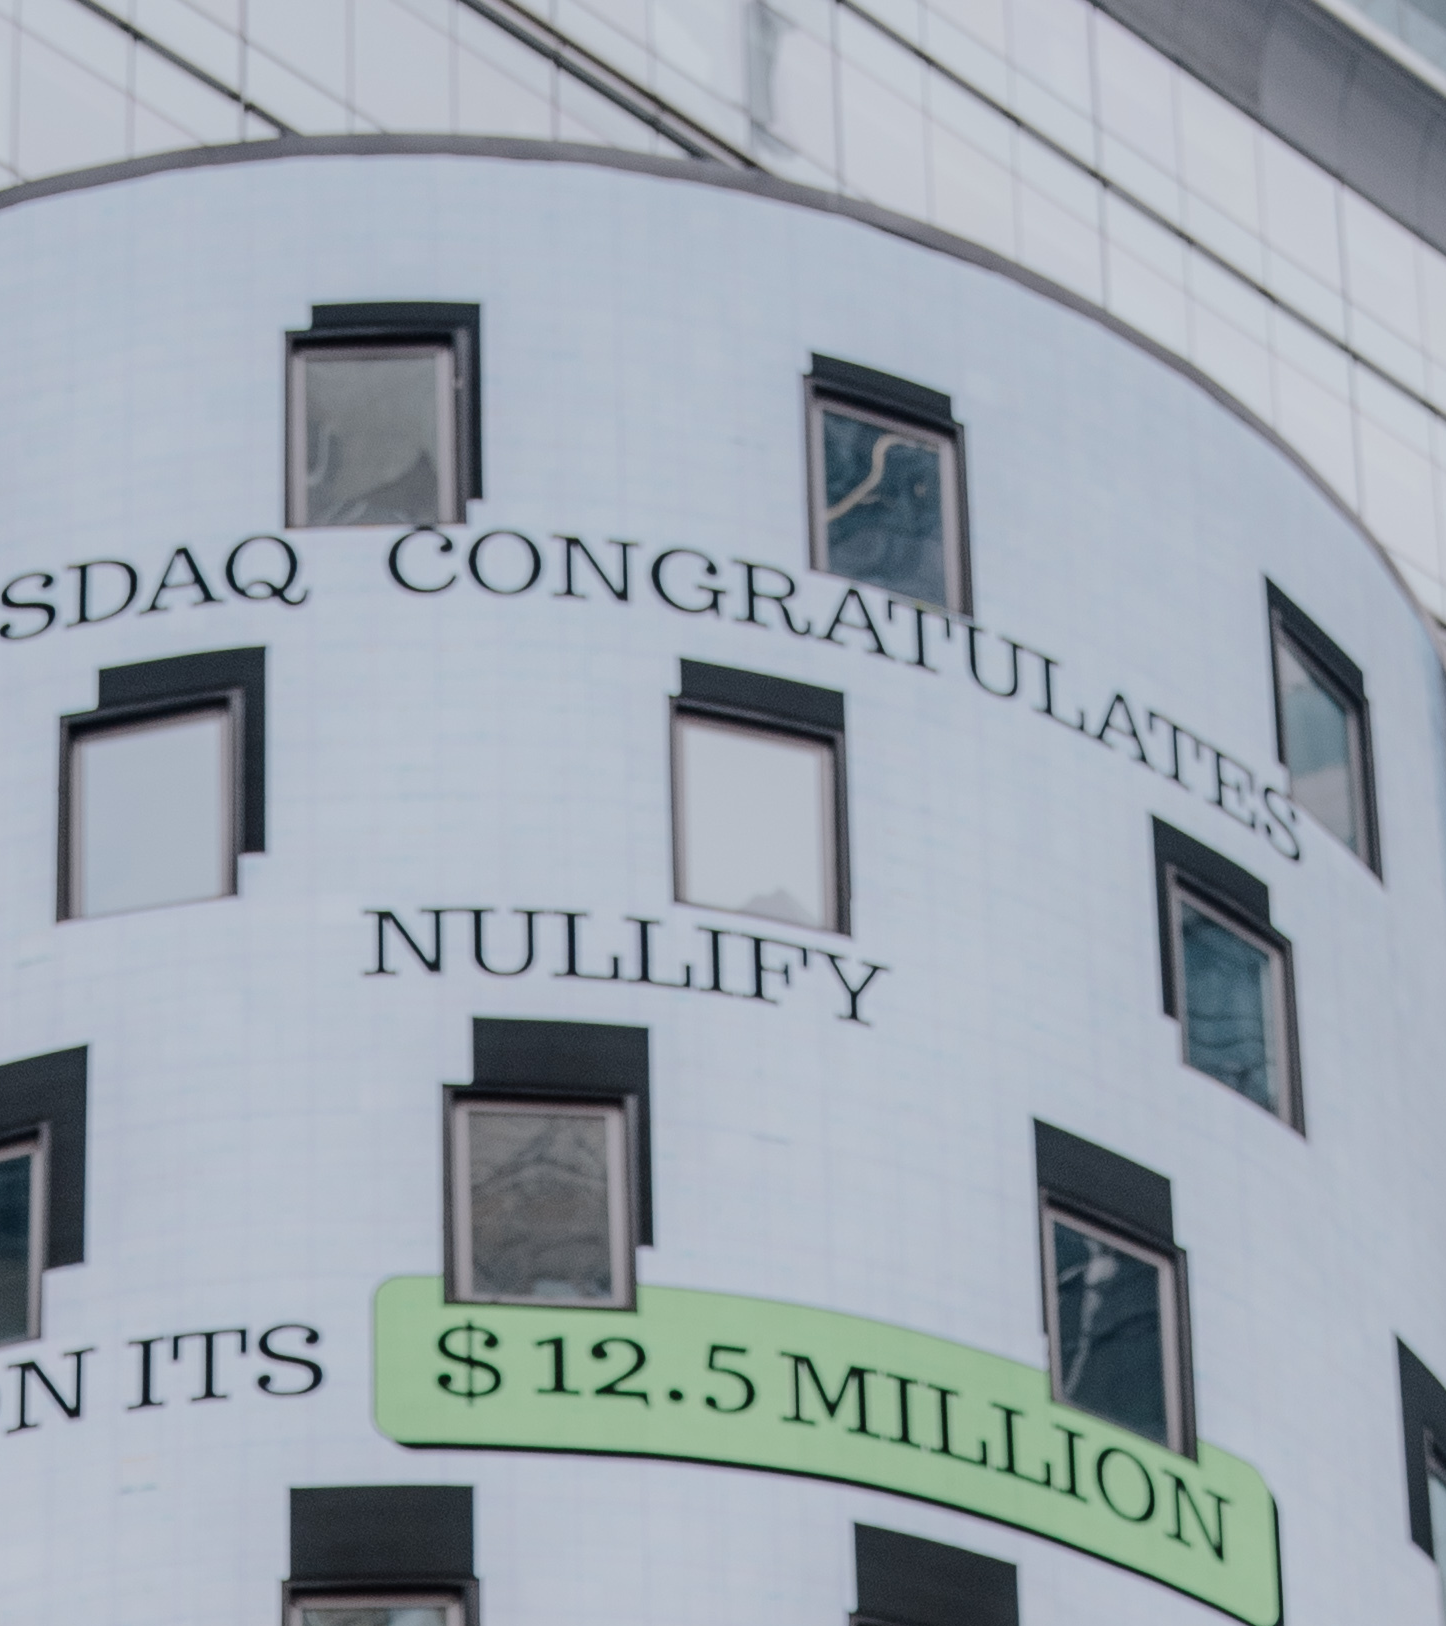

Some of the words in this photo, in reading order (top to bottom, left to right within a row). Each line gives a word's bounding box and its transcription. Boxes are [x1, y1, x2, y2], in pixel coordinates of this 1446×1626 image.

[388, 525, 1303, 863] CONGRATULATES
[362, 907, 890, 1027] NULLIFY
[124, 1322, 325, 1411] ITS
[436, 1319, 758, 1417] $12.5
[777, 1348, 1230, 1565] MILLION
